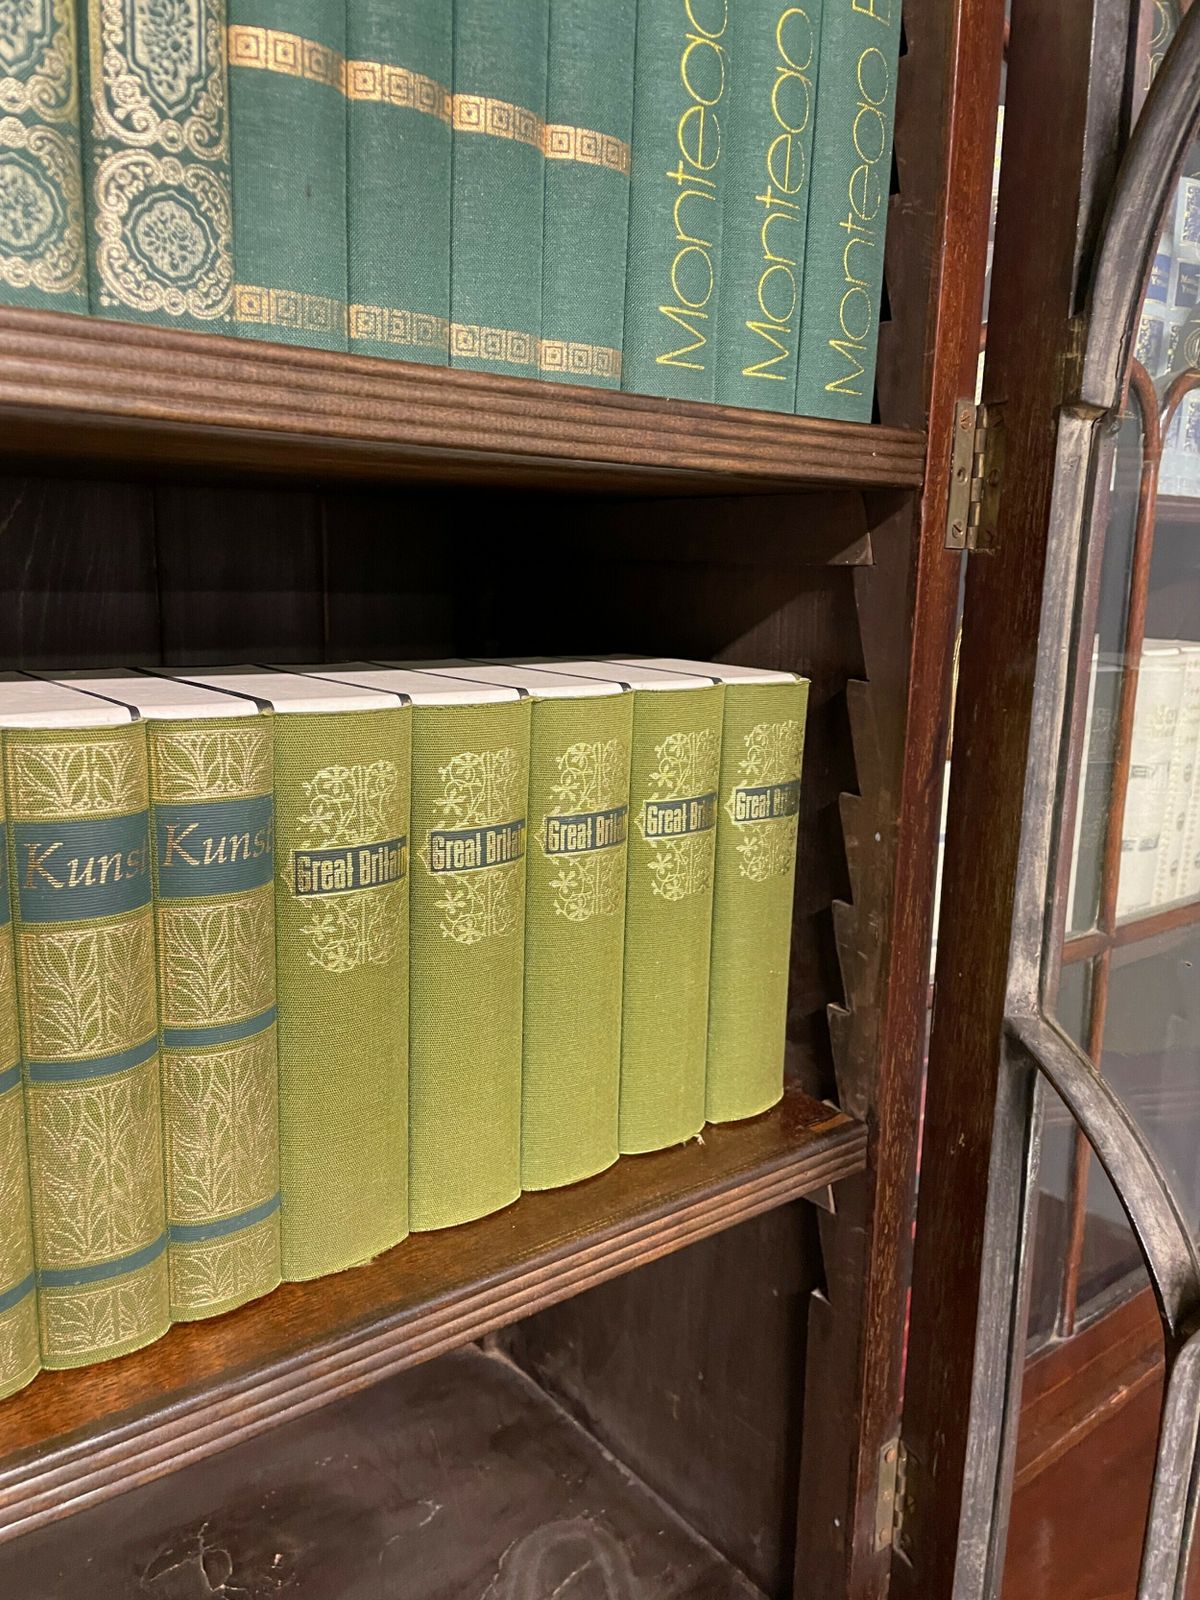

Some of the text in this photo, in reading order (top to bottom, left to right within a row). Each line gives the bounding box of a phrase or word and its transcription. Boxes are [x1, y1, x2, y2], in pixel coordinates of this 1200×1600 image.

[646, 803, 687, 835] Great
[736, 789, 770, 820] Great
[432, 832, 481, 869] Great
[548, 817, 592, 851] Great
[299, 851, 353, 892] Great
